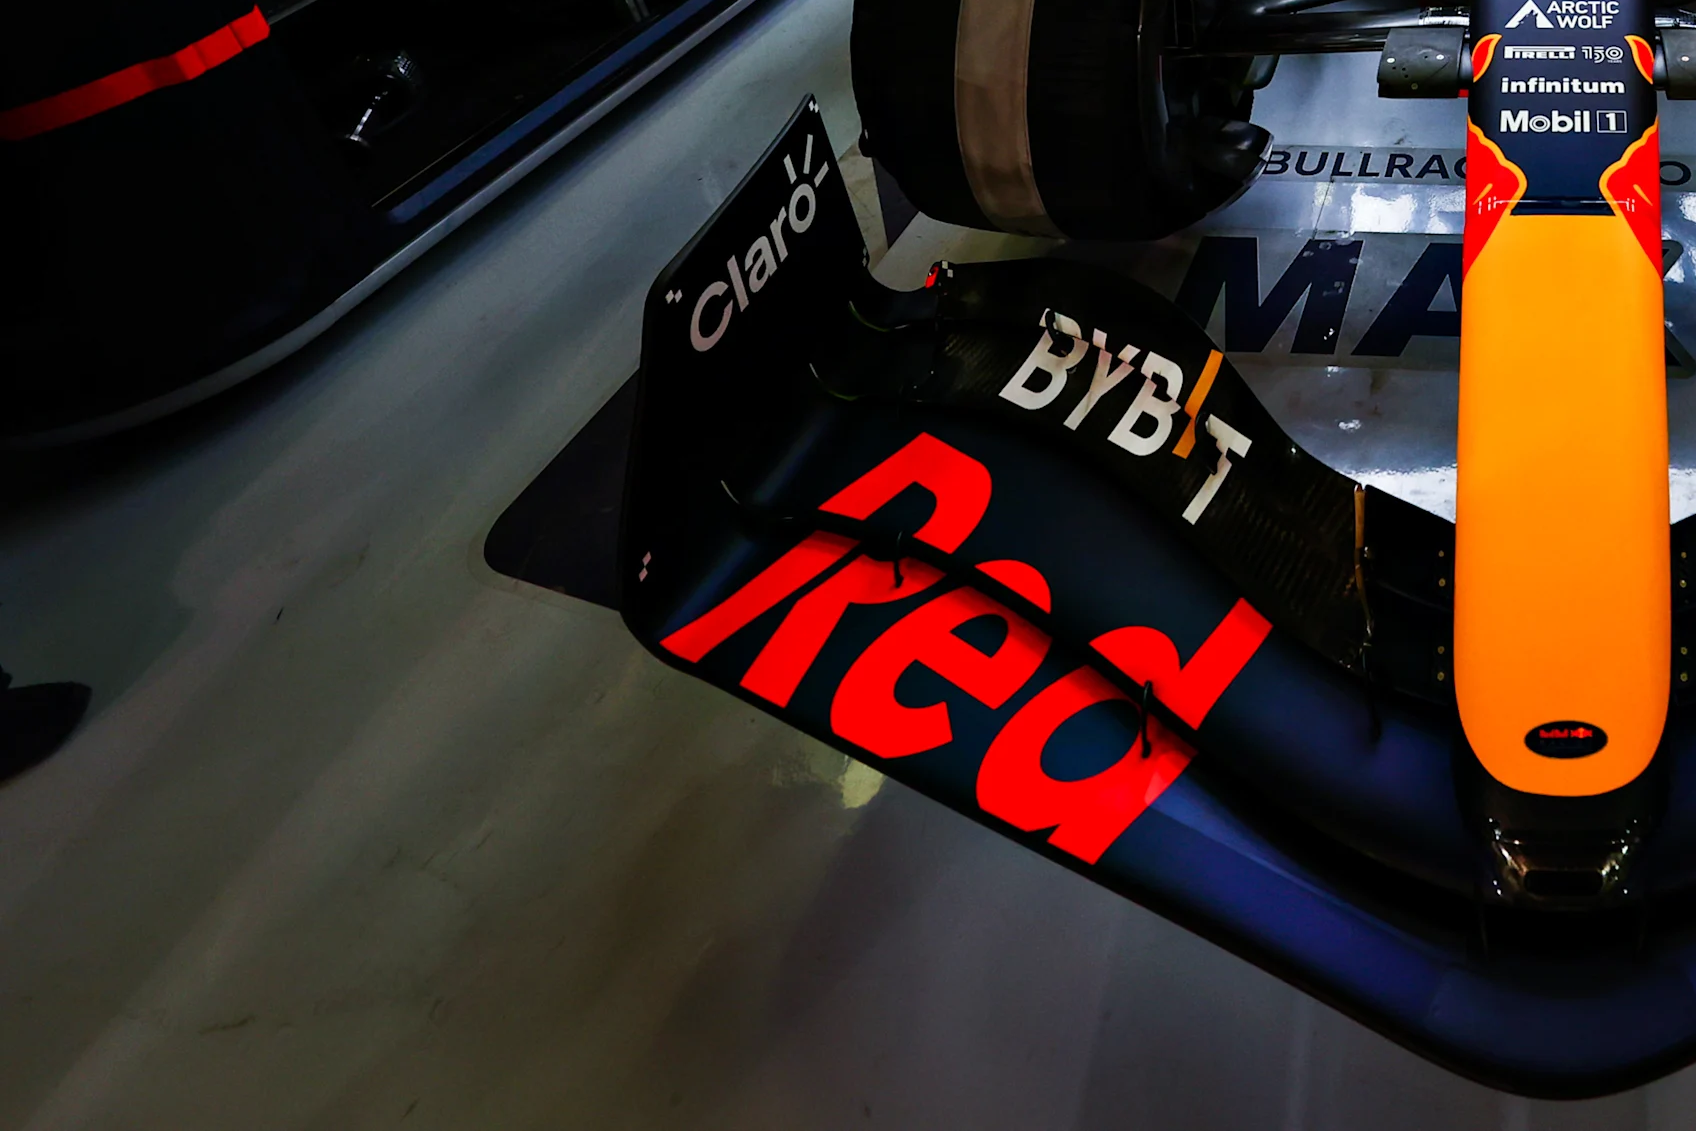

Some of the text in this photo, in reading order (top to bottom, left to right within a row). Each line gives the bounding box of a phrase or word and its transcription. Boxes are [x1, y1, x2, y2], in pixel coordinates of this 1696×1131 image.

[1547, 1, 1620, 14] ARCTIC
[1556, 15, 1613, 28] WOLF
[1504, 46, 1624, 64] PIRELLI 150
[1501, 77, 1625, 94] infinitum
[1500, 110, 1591, 133] Mobil
[689, 160, 822, 353] Claro
[999, 307, 1253, 526] BYBIT
[660, 432, 1273, 865] Red
